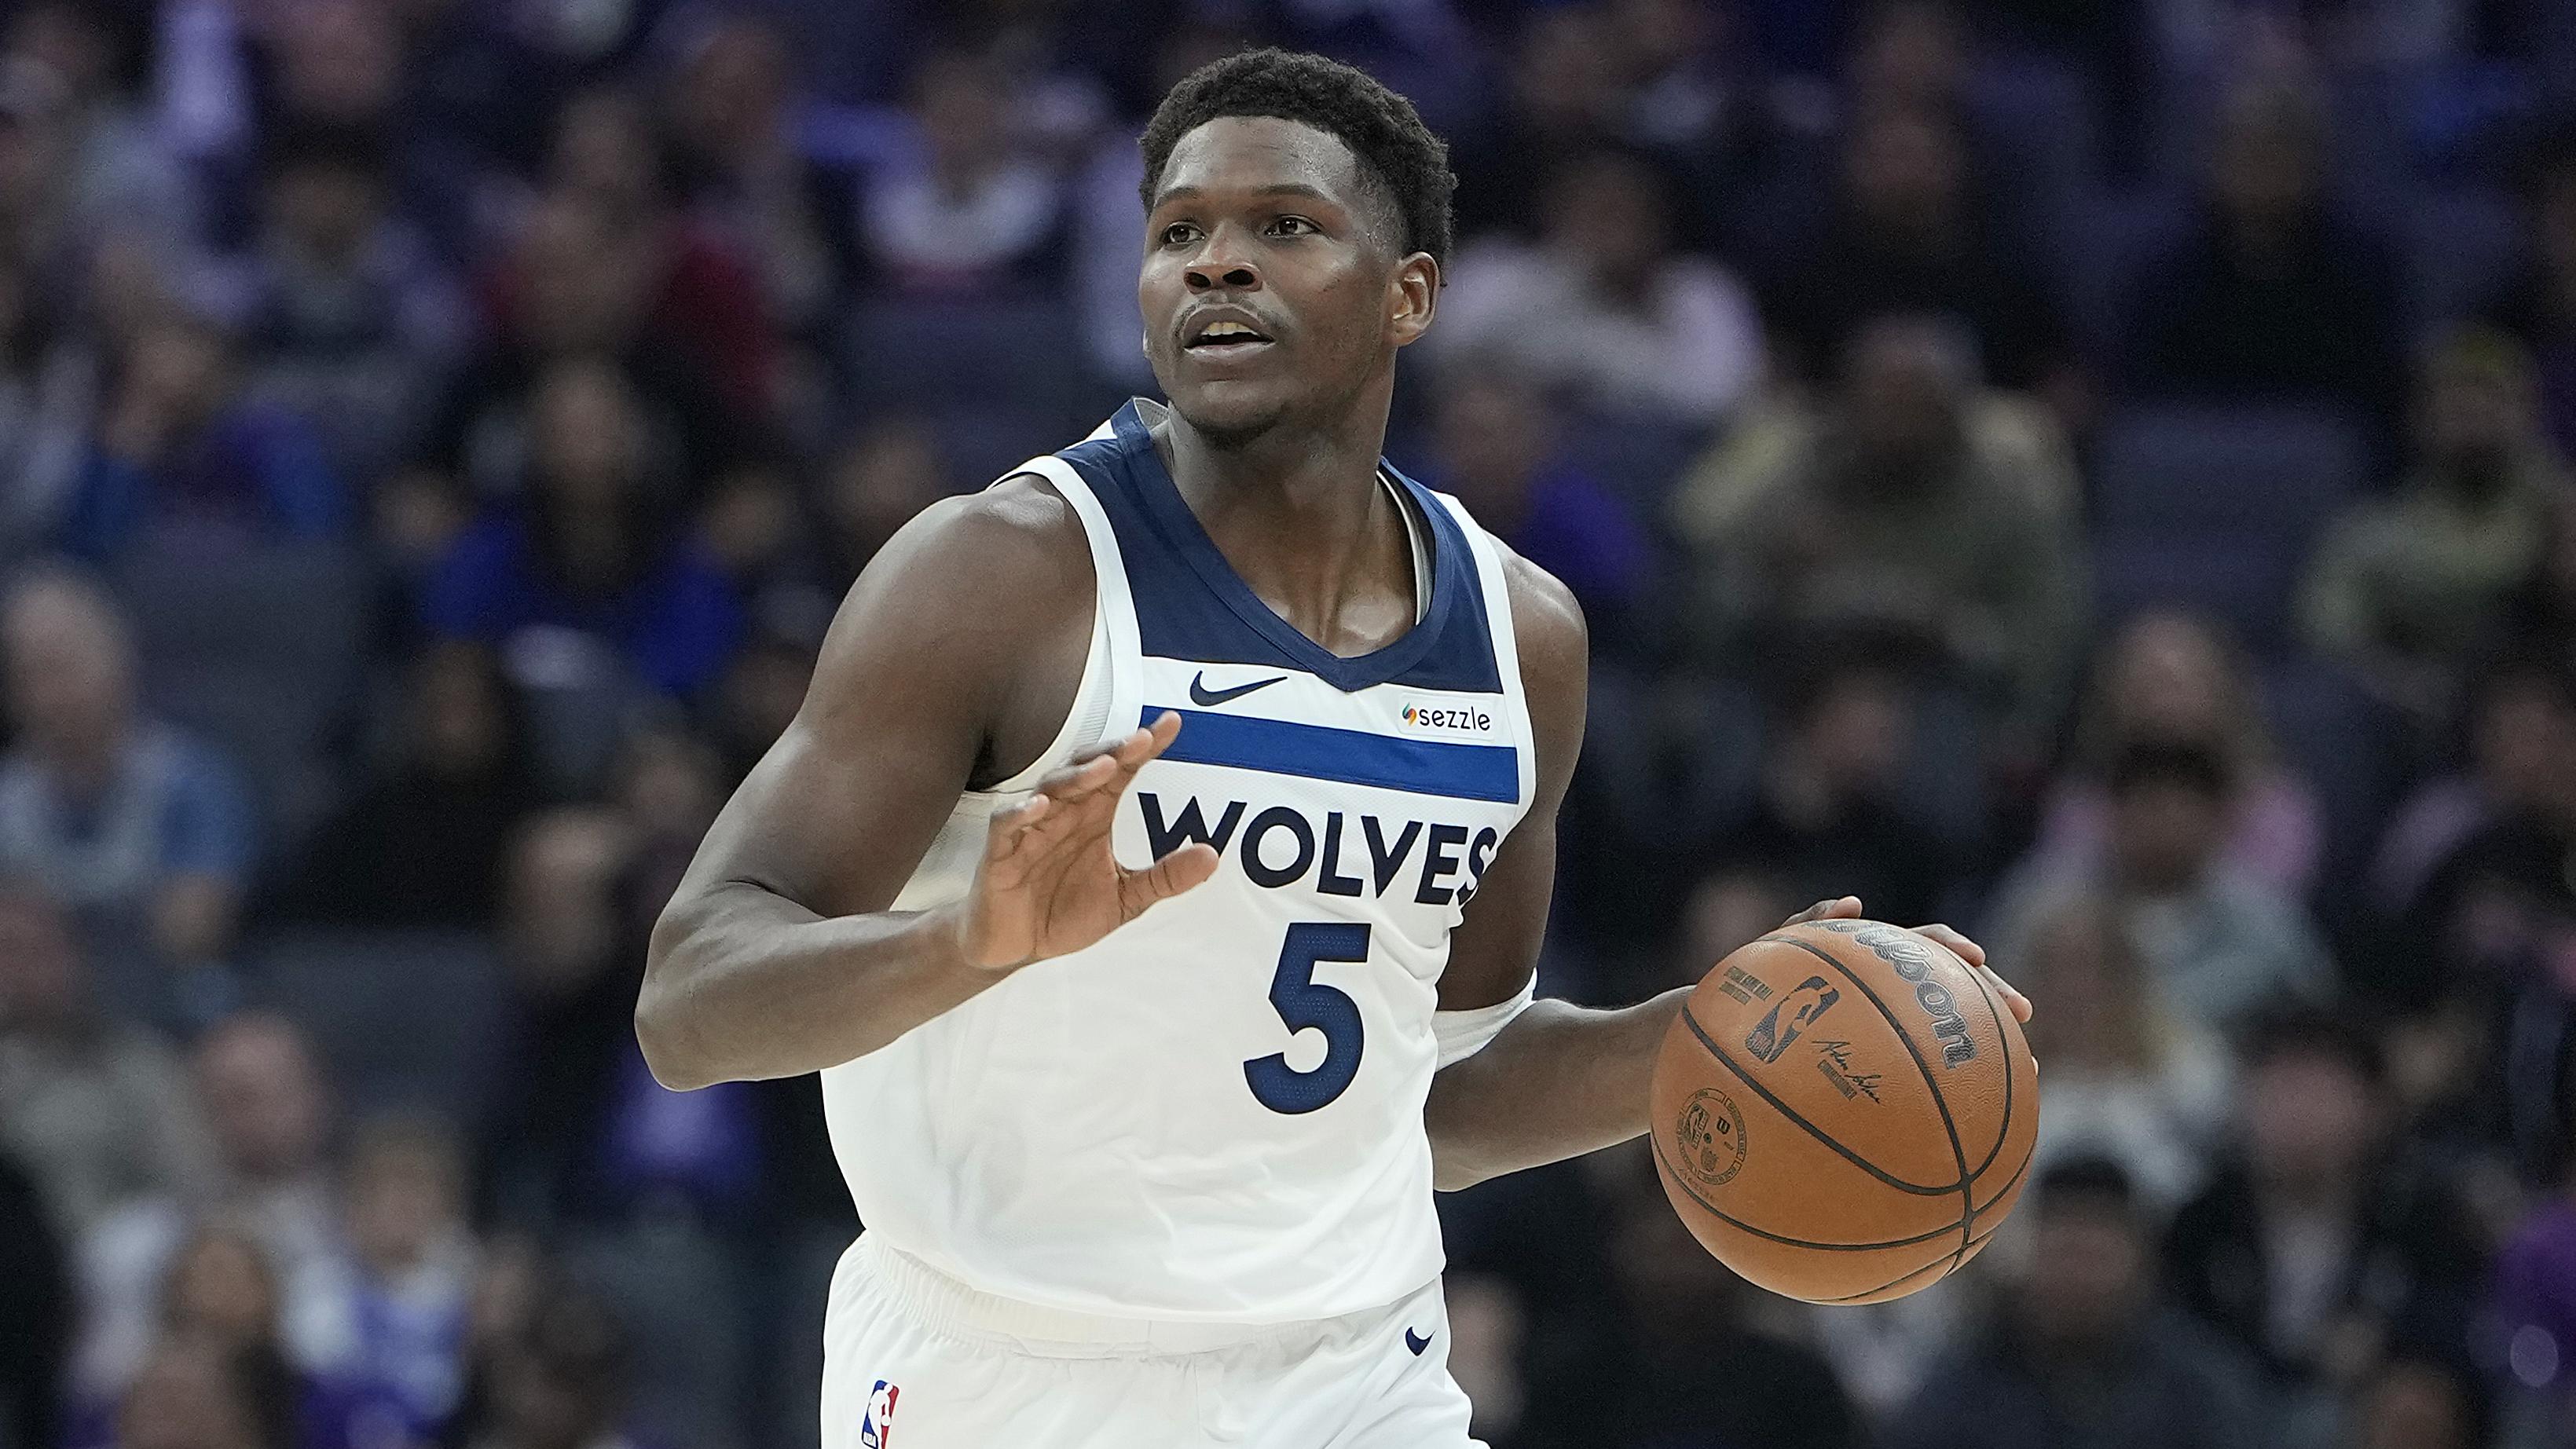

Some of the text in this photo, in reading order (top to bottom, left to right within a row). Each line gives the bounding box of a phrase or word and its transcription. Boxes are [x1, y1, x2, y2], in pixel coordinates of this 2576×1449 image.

[1419, 706, 1490, 730] sezzle
[1138, 792, 1497, 906] WOLVES
[1244, 923, 1372, 1114] 5
